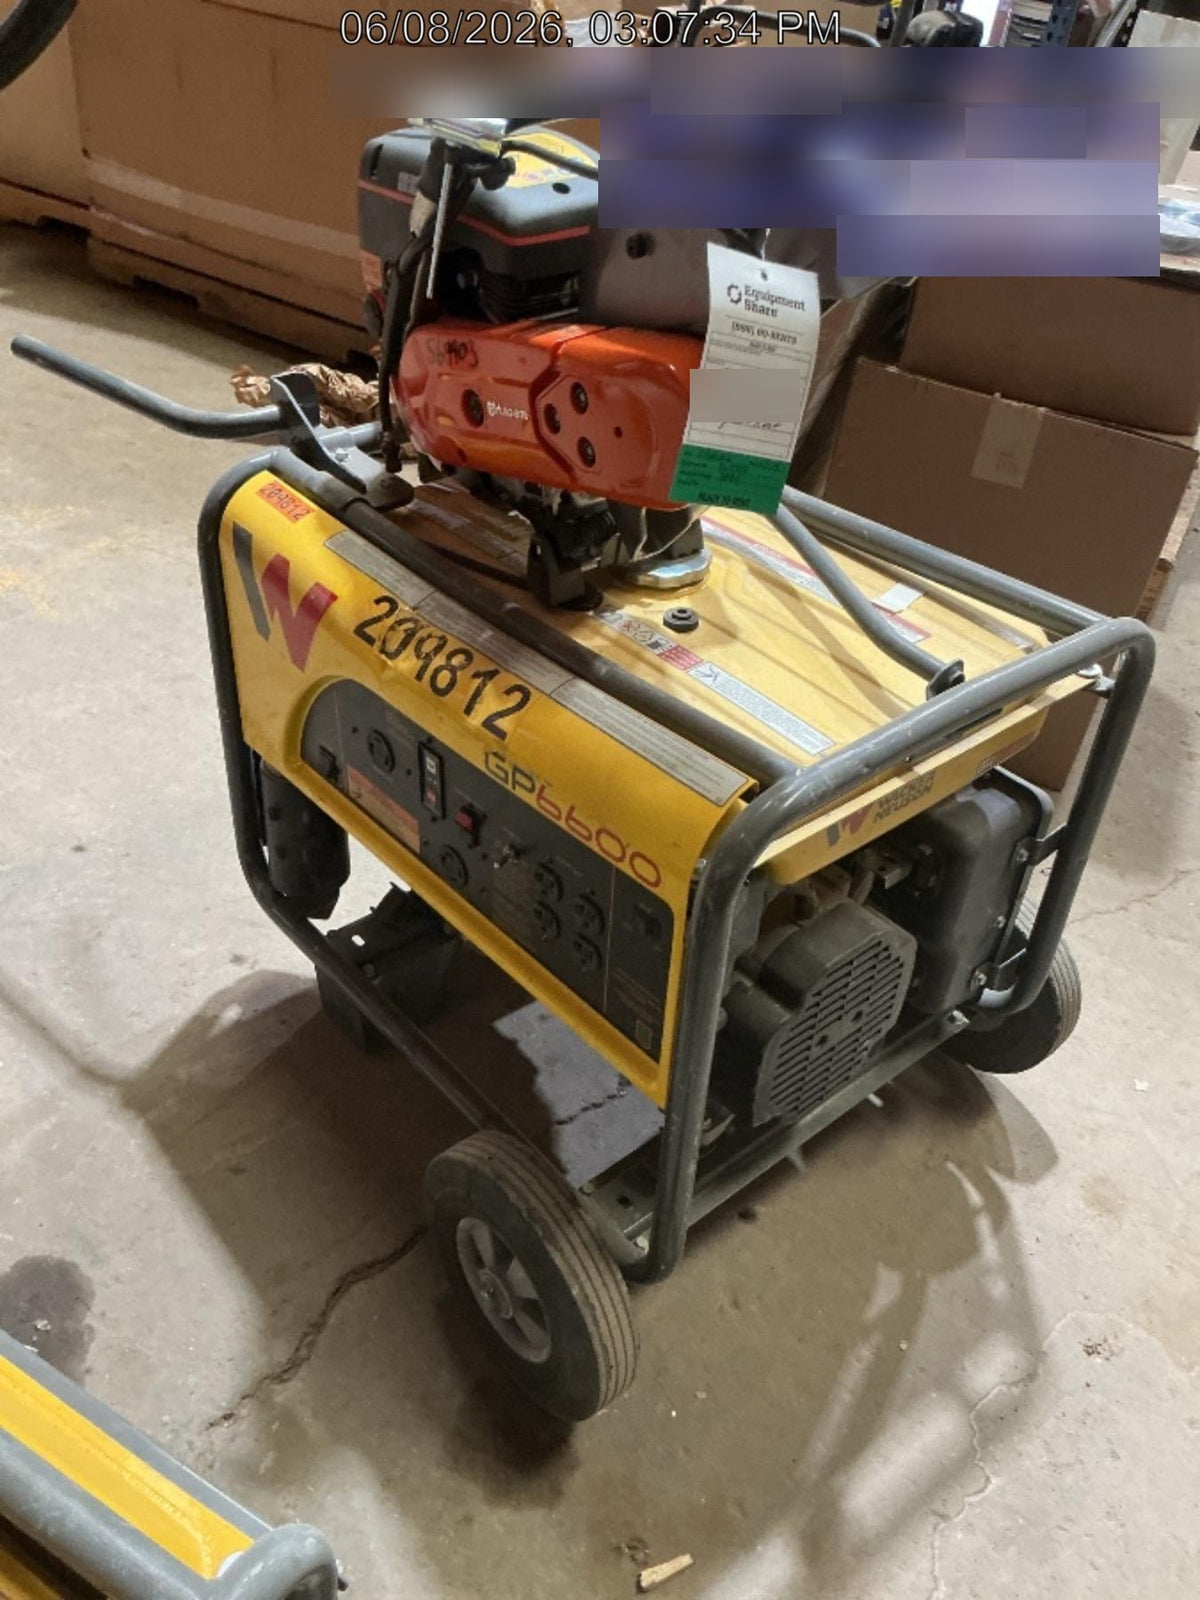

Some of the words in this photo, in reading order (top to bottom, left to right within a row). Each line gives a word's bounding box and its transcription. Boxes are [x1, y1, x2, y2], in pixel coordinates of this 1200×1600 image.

[744, 285, 806, 312] Equipment
[744, 299, 779, 318] Share
[352, 594, 532, 742] 209812
[484, 750, 663, 889] GP6600
